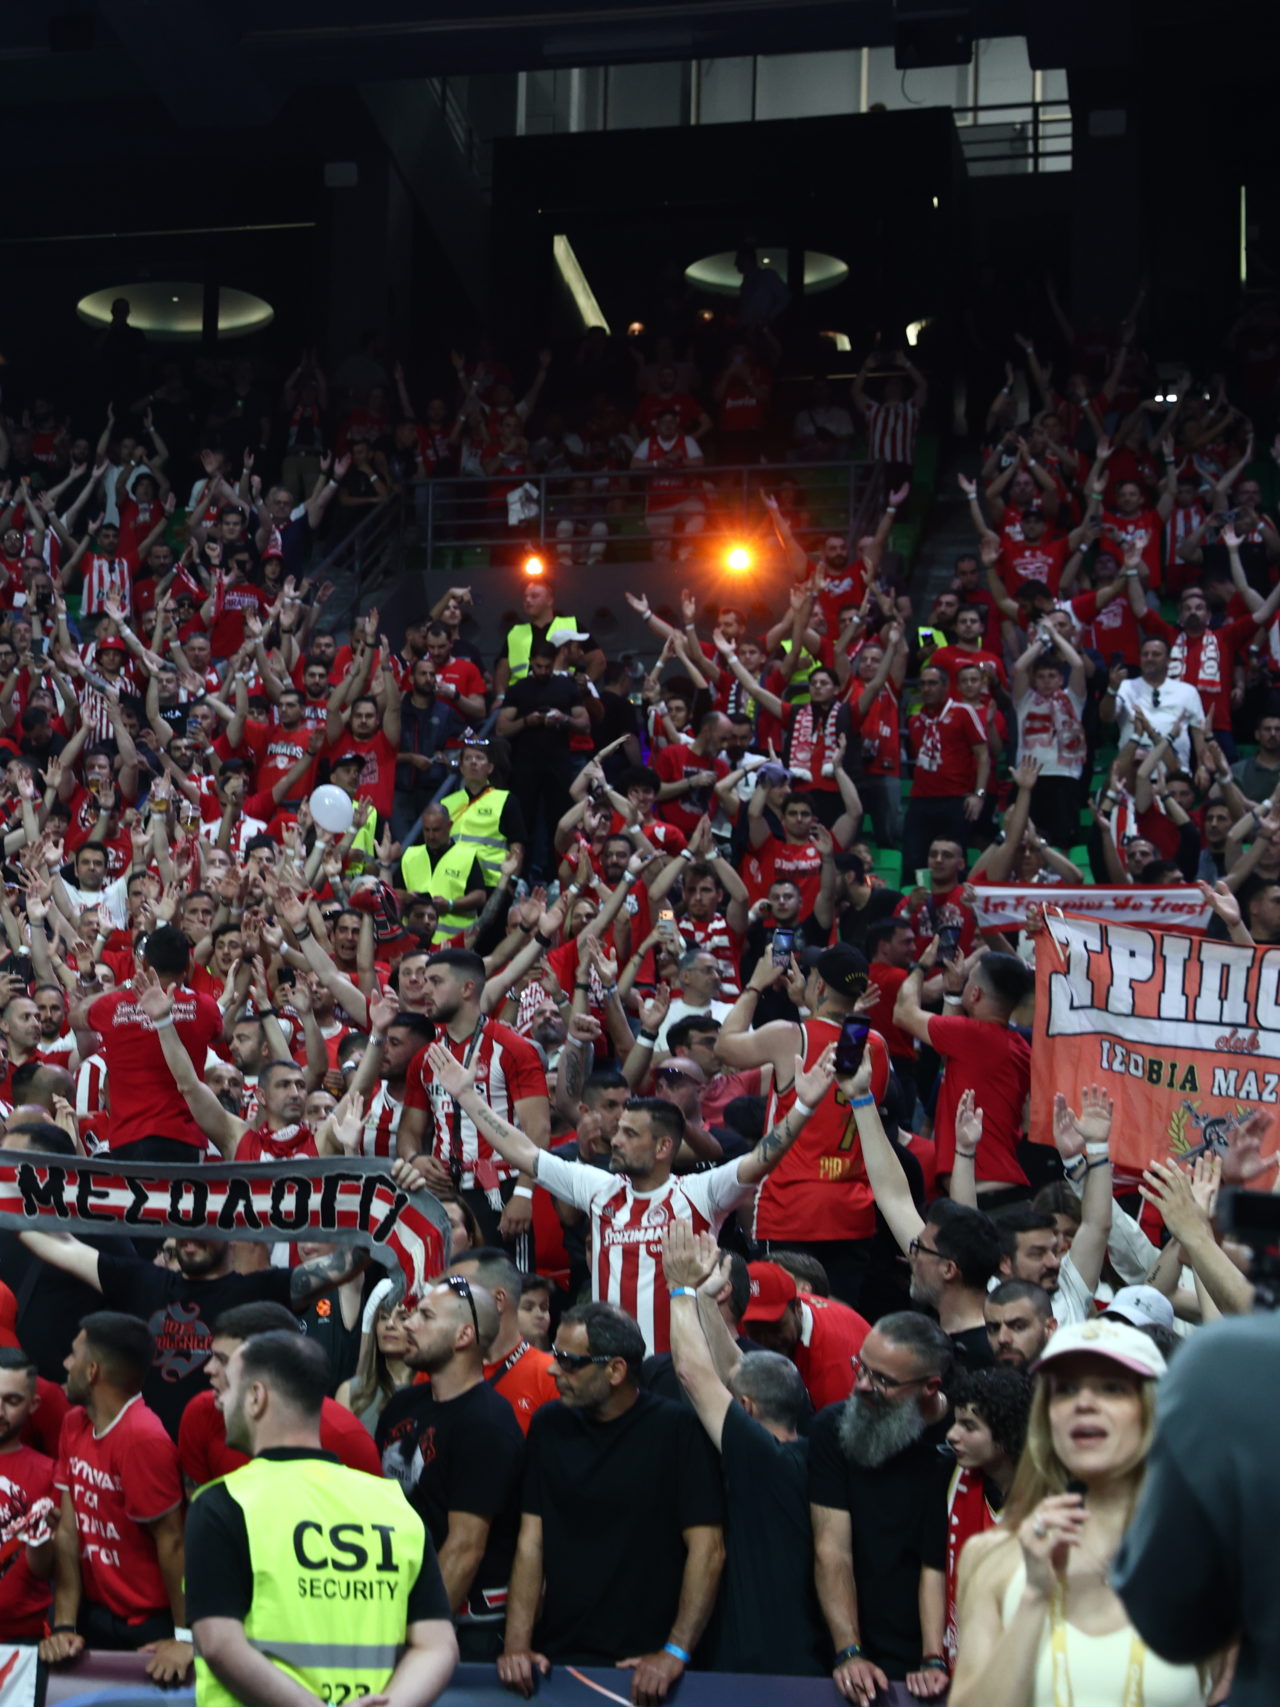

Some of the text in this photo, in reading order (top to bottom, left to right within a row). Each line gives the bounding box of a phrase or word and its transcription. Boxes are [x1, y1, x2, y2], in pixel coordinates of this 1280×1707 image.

[1215, 1028, 1261, 1052] club
[17, 1163, 409, 1244] ΜΕΣΟΛΟΓΓΙ
[292, 1520, 400, 1573] CSI
[298, 1578, 399, 1601] SECURITY
